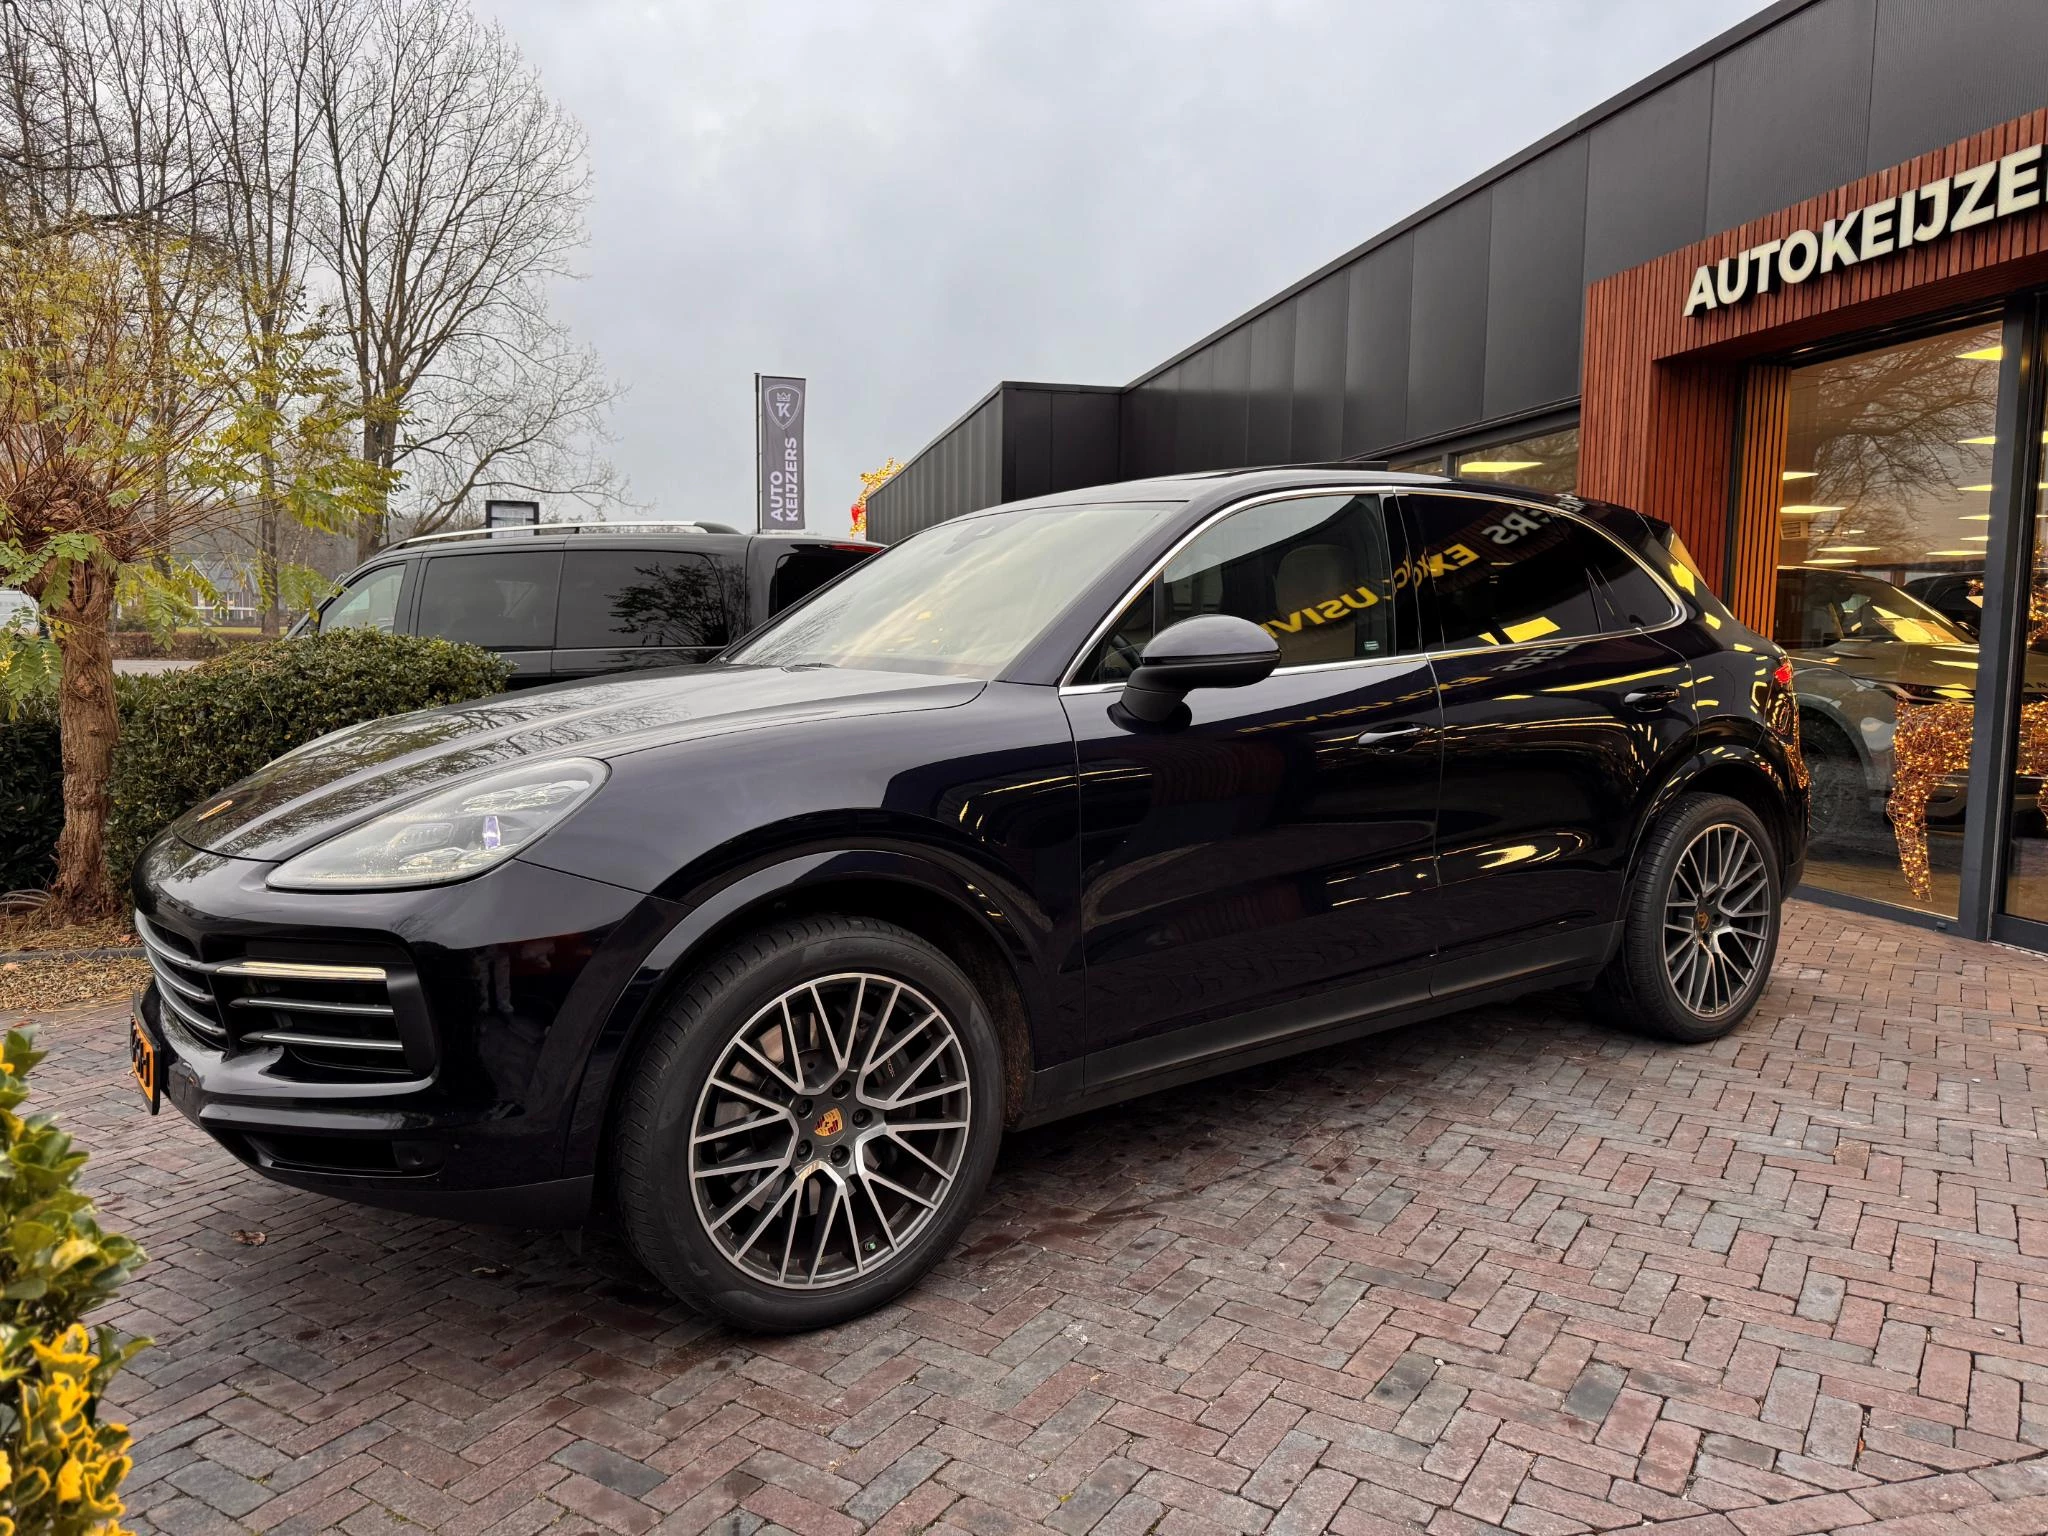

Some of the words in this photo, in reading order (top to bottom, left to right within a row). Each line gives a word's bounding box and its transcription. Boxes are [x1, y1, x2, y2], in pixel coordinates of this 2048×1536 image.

[1683, 144, 2048, 317] AUTOKEIJZE
[770, 471, 783, 521] AUTO
[785, 437, 798, 522] KEIJZERS
